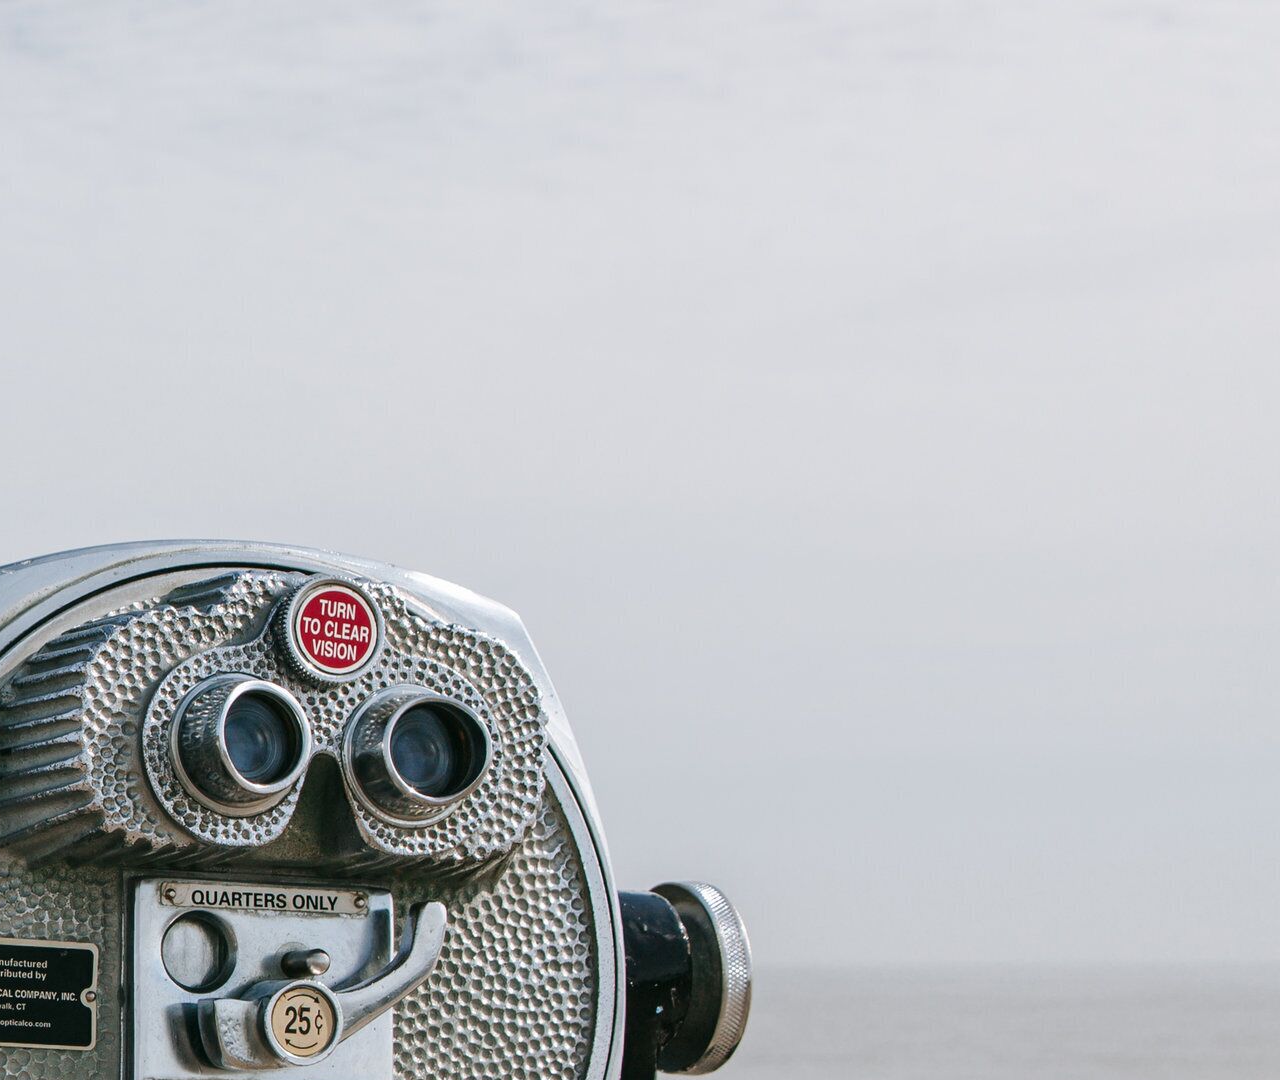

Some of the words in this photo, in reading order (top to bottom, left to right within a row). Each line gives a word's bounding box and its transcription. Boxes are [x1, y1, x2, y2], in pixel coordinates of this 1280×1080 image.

[319, 599, 357, 620] TURN
[303, 617, 321, 635] TO
[324, 621, 370, 643] CLEAR
[312, 639, 357, 661] VISION
[191, 889, 287, 909] QUARTERS
[292, 893, 338, 911] ONLY
[35, 970, 47, 982] by
[14, 989, 60, 1002] COMPANY,
[61, 992, 78, 1002] INC.
[16, 1003, 26, 1011] CT
